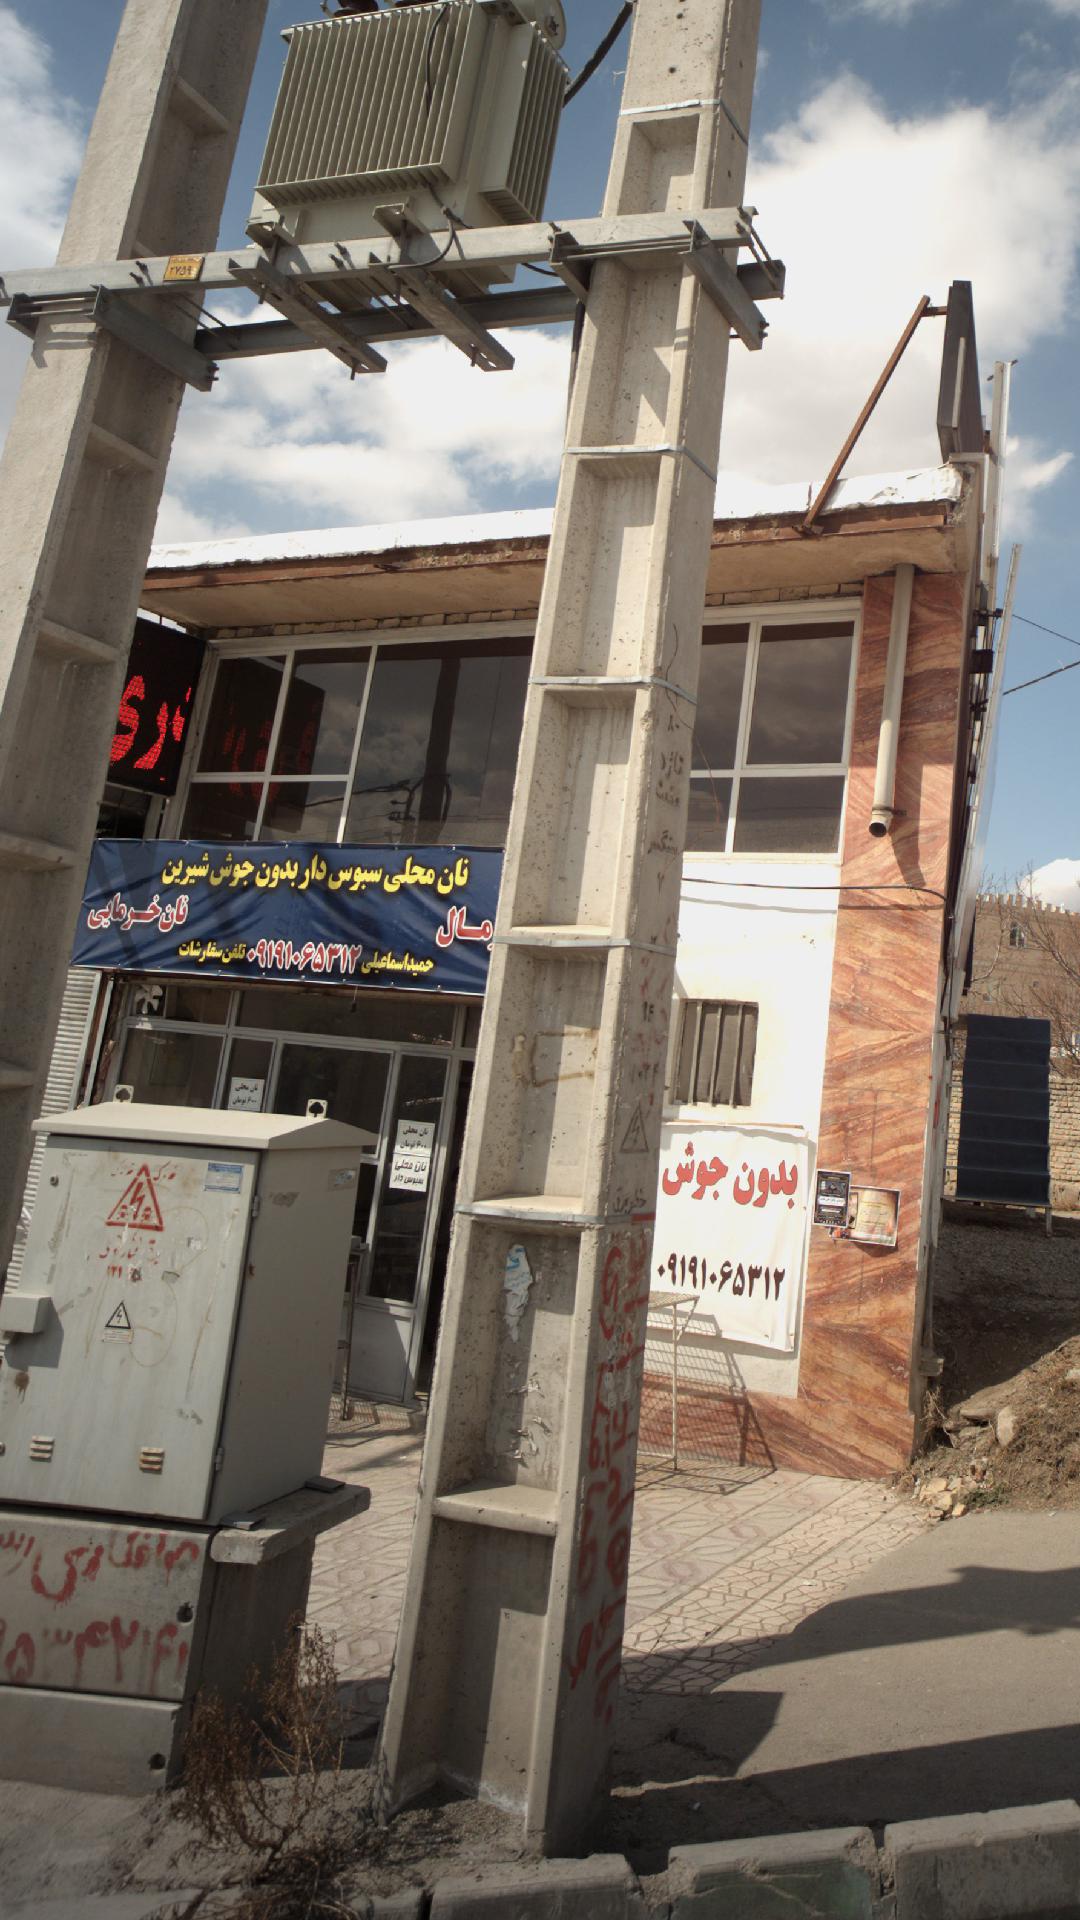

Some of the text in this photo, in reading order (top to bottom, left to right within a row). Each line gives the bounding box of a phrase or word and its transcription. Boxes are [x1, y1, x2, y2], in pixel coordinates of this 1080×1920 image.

[161, 852, 469, 894] نان محلی سبوس دار بدون جوش شیرین
[159, 894, 190, 932] نان
[178, 940, 223, 962] سفارشات
[222, 943, 247, 963] تلفن
[247, 939, 363, 974] ۰۹۱۹۱۰۶۵۳۱۲
[662, 1141, 729, 1200] جوش
[733, 1159, 799, 1209] بدون
[657, 1253, 786, 1301] ۰۹۱۹۱۰۶۵۳۱۲
